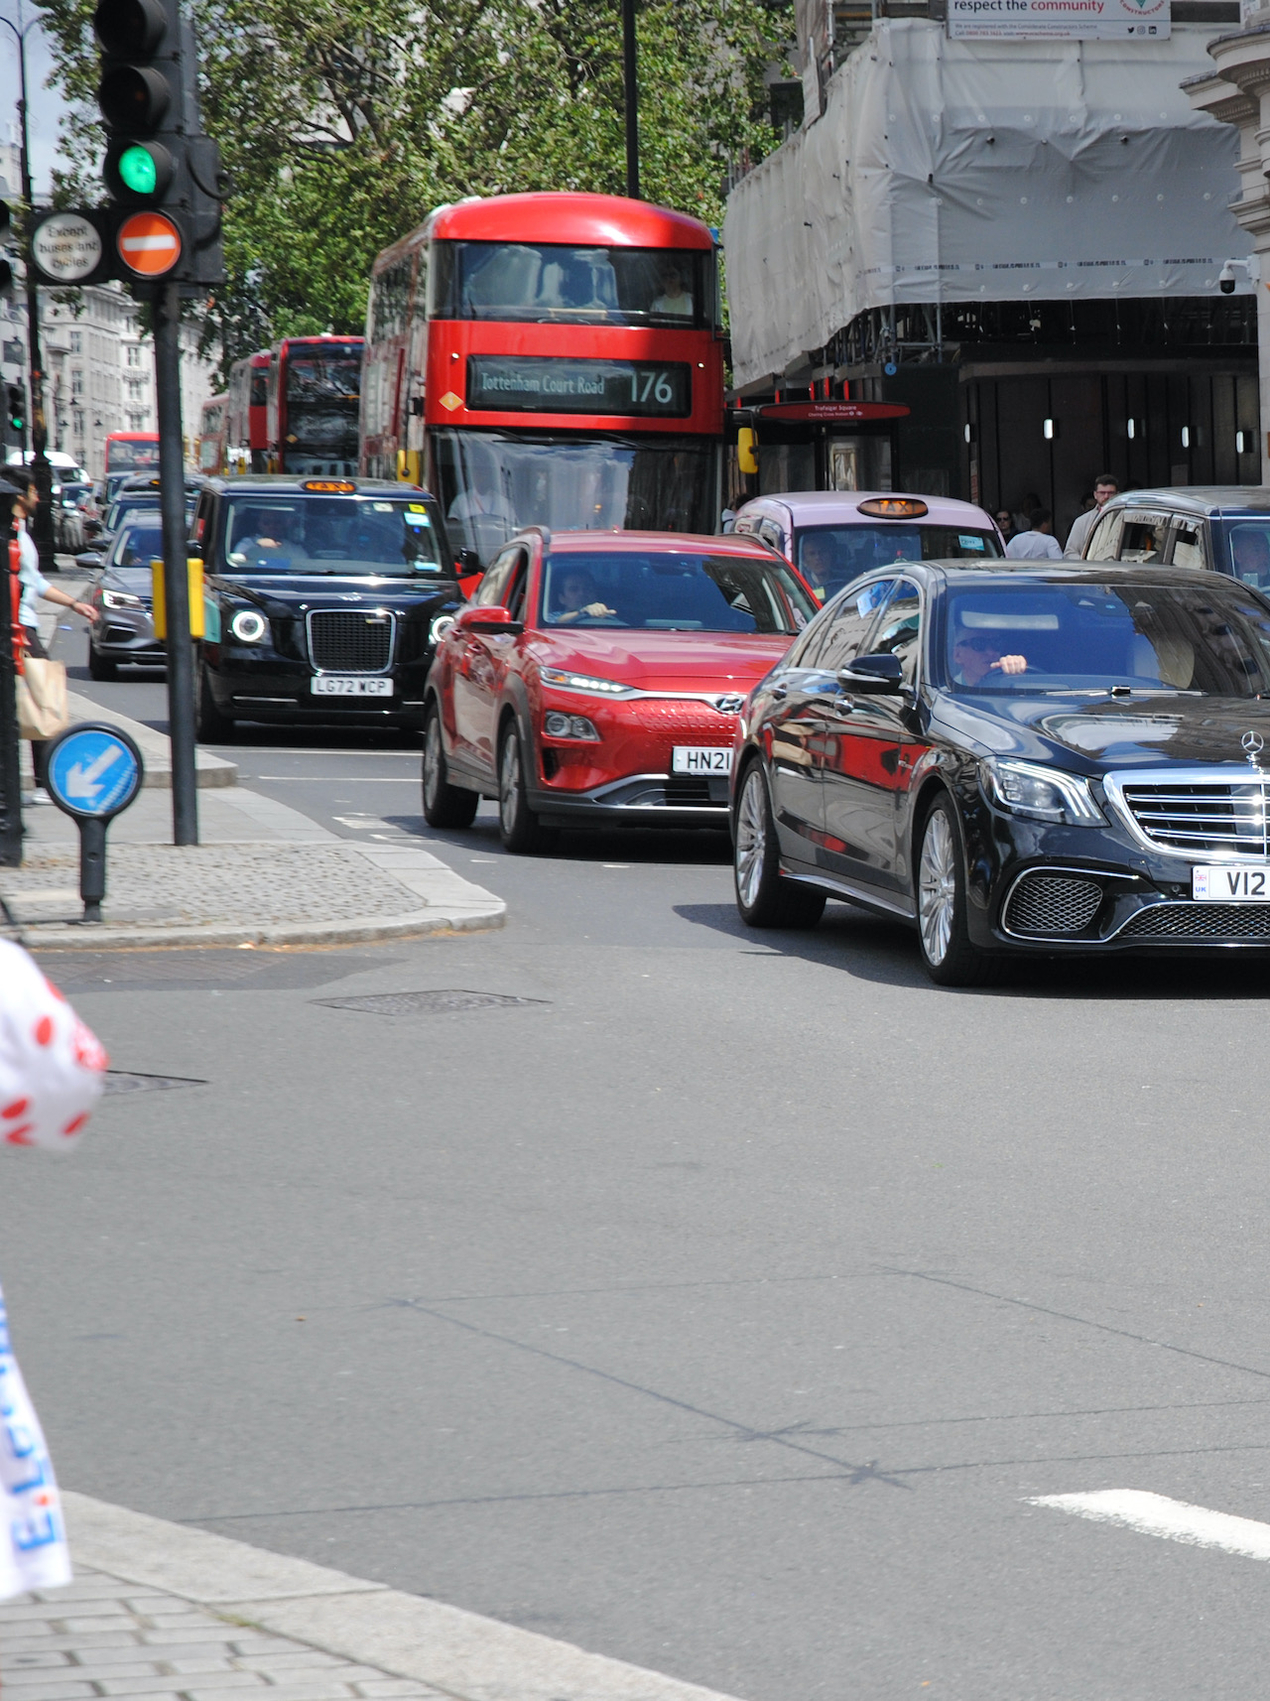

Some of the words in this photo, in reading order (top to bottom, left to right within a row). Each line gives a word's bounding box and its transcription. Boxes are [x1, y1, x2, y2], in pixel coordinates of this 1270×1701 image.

[954, 0, 1002, 13] respect
[1006, 0, 1027, 10] the
[1031, 0, 1104, 13] community
[48, 225, 88, 238] Except
[39, 243, 74, 253] buses
[78, 239, 99, 252] and
[52, 257, 89, 270] cycles
[482, 372, 540, 392] Tottenham
[543, 375, 574, 394] Court
[577, 376, 605, 395] Road
[630, 371, 673, 404] 176
[310, 482, 350, 490] TAXI
[876, 500, 917, 513] TAXI
[316, 680, 354, 693] LG72
[687, 751, 730, 770] HN21
[1226, 871, 1266, 896] V12
